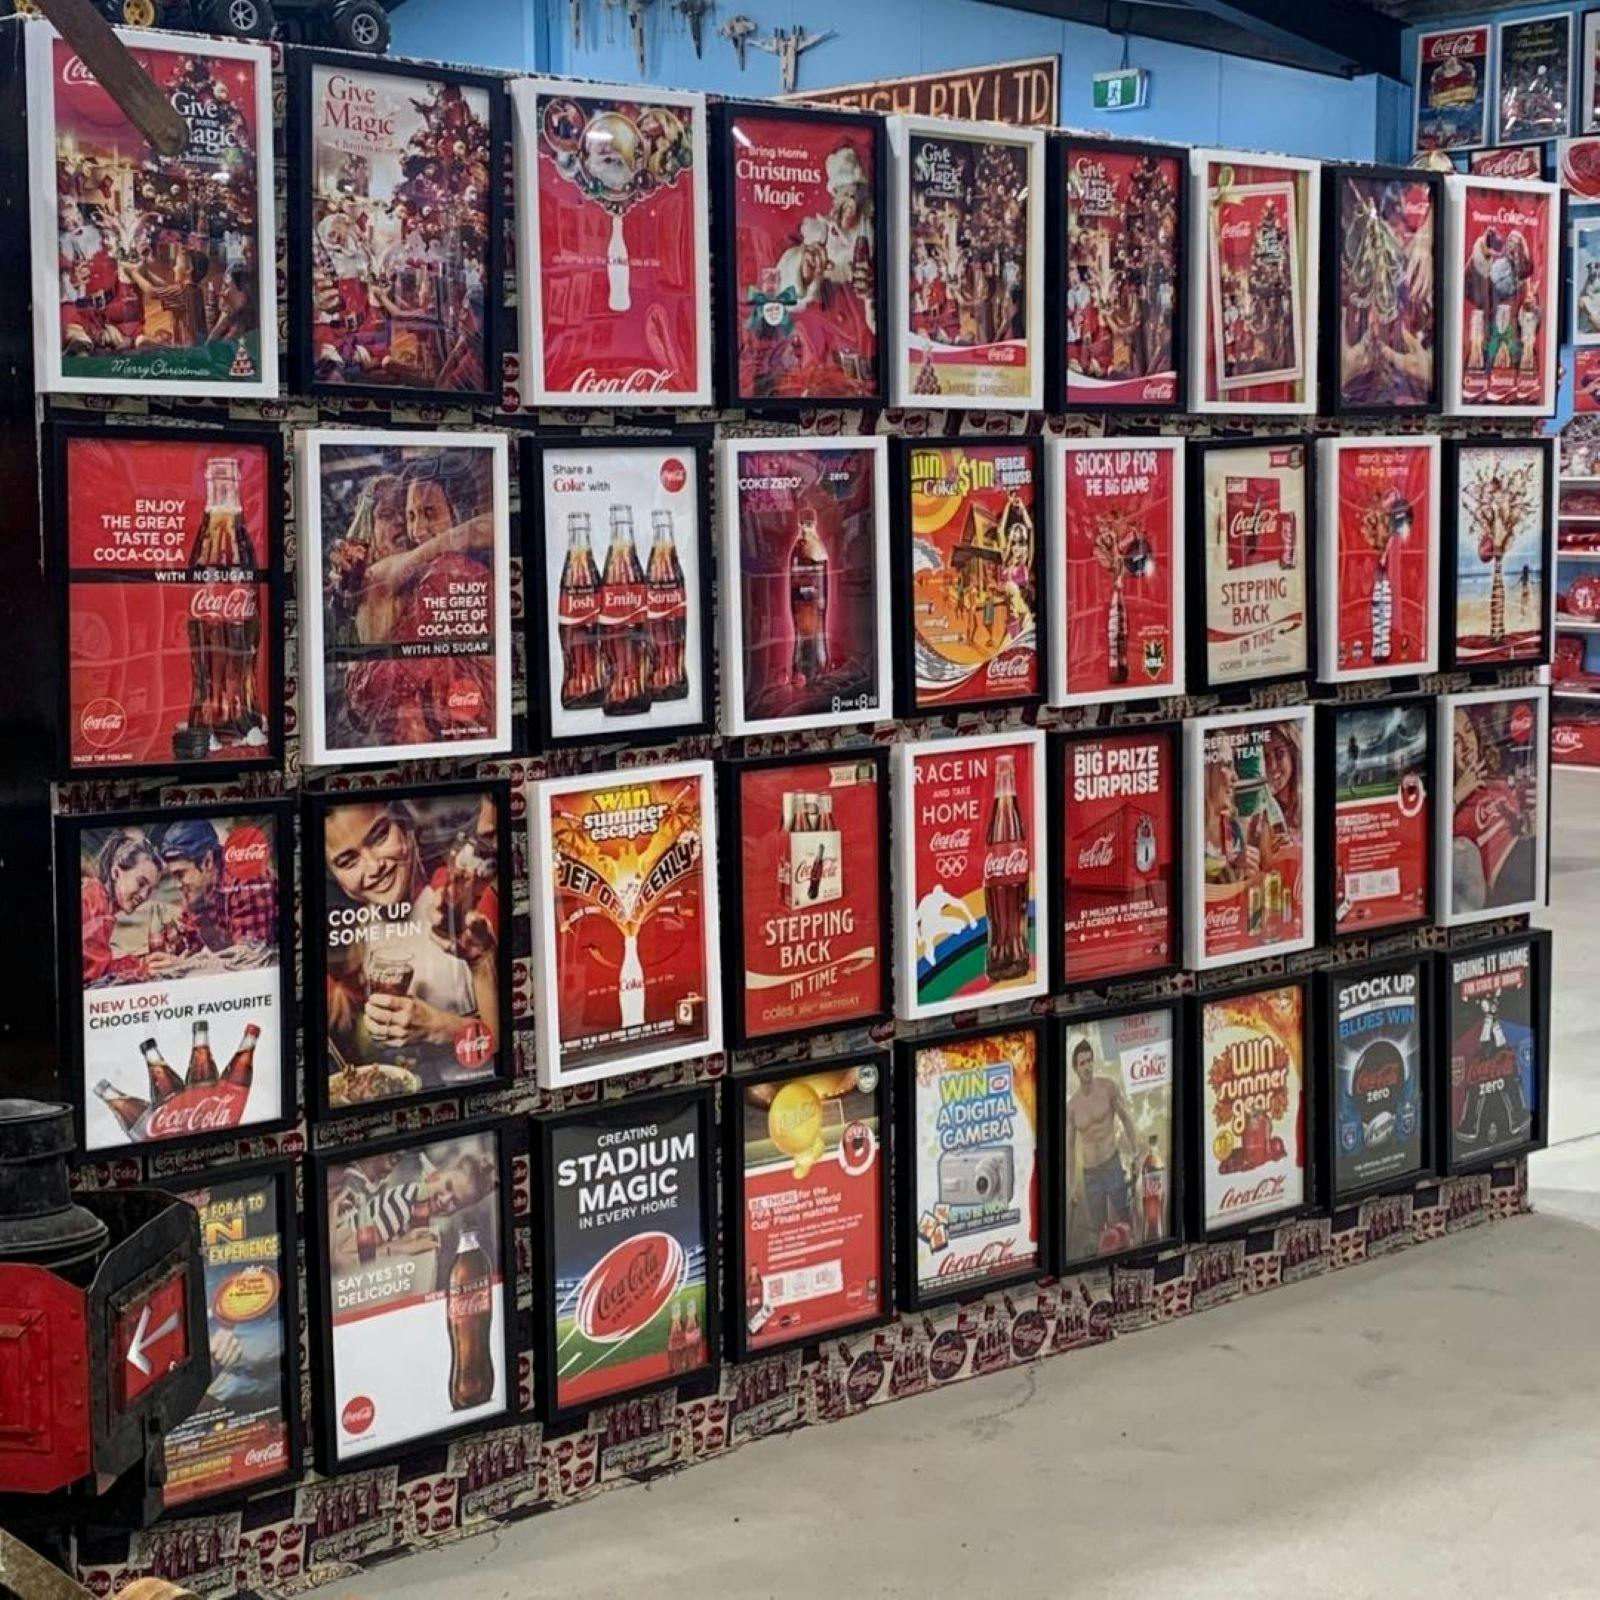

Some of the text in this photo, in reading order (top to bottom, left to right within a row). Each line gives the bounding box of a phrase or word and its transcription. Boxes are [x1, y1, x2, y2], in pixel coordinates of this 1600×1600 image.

[1431, 34, 1477, 58] Coca-Cola
[328, 75, 376, 103] Give
[171, 92, 218, 117] Give
[321, 100, 395, 141] Magic
[779, 147, 808, 159] Home
[922, 142, 951, 162] Give
[736, 159, 821, 183] Christmas
[1075, 157, 1106, 178] Give
[754, 183, 804, 210] Magic
[553, 464, 593, 475] Share a
[1075, 452, 1157, 478] STOCK UP FOR
[553, 478, 611, 493] Coke with
[923, 479, 957, 497] Coke
[1085, 477, 1149, 497] THE BIG GAME
[135, 499, 185, 513] ENJOY
[101, 515, 185, 530] THE GREAT
[1230, 508, 1278, 538] Coca-Cola
[113, 532, 185, 546] TASTE OF
[94, 548, 185, 562] COCA-COLA
[155, 570, 254, 582] WITH NO SUGAR
[449, 582, 487, 594] ENJOY
[190, 588, 257, 618] Coca-Cola
[423, 596, 487, 609] THE GREAT
[567, 595, 595, 611] Josh
[604, 591, 643, 608] Emily
[647, 590, 682, 603] Sarah
[1221, 576, 1287, 605] STEPPING
[432, 609, 488, 622] TASTE OF
[1232, 604, 1270, 626] BACK
[417, 623, 488, 637] COCA-COLA
[1240, 628, 1275, 654] IN TIME
[401, 642, 488, 656] WITH NO SUGAR
[83, 714, 122, 731] Coca-Cola
[1251, 729, 1271, 744] THE
[913, 758, 988, 785] RACE IN
[1074, 746, 1159, 777] BIG PRIZE
[1074, 769, 1159, 801] SURPRISE
[584, 804, 669, 829] summer
[922, 800, 980, 825] HOME
[591, 820, 658, 841] escapes
[225, 844, 267, 863] Coca-Cola
[984, 848, 1028, 879] Coca-Cola
[559, 862, 598, 894] JET
[328, 902, 412, 927] COOK UP
[765, 908, 854, 946] STEPPING
[328, 920, 422, 947] SOME FUN
[780, 940, 830, 968] BACK
[1453, 957, 1485, 983] BRING
[1486, 954, 1497, 974] IT
[1499, 947, 1528, 971] HOME
[790, 966, 838, 1000] IN TIME
[1339, 974, 1415, 1010] STOCK UP
[89, 993, 170, 1015] NEW LOOK
[89, 994, 273, 1030] CHOOSE YOUR FAVOURITE
[1339, 1005, 1415, 1039] BLUES WIN
[1130, 1059, 1166, 1081] Coke
[939, 1072, 988, 1102] WIN
[1218, 1067, 1287, 1101] summer
[1367, 1087, 1390, 1103] zero
[1479, 1078, 1505, 1096] zero
[146, 1094, 235, 1137] Coca-Cola
[938, 1097, 1016, 1128] A DIGITAL
[1232, 1091, 1273, 1134] gear
[597, 1124, 658, 1147] CREATING
[941, 1122, 1012, 1149] CAMERA
[557, 1133, 695, 1187] STADIUM
[579, 1168, 679, 1214] MAGIC
[1220, 1175, 1287, 1209] Coca-Cola
[579, 1196, 678, 1230] IN EVERY HOME
[938, 1238, 1017, 1276] Coca-Cola
[338, 1262, 415, 1293] SAY YES TO
[338, 1280, 411, 1308] DELICIOUS
